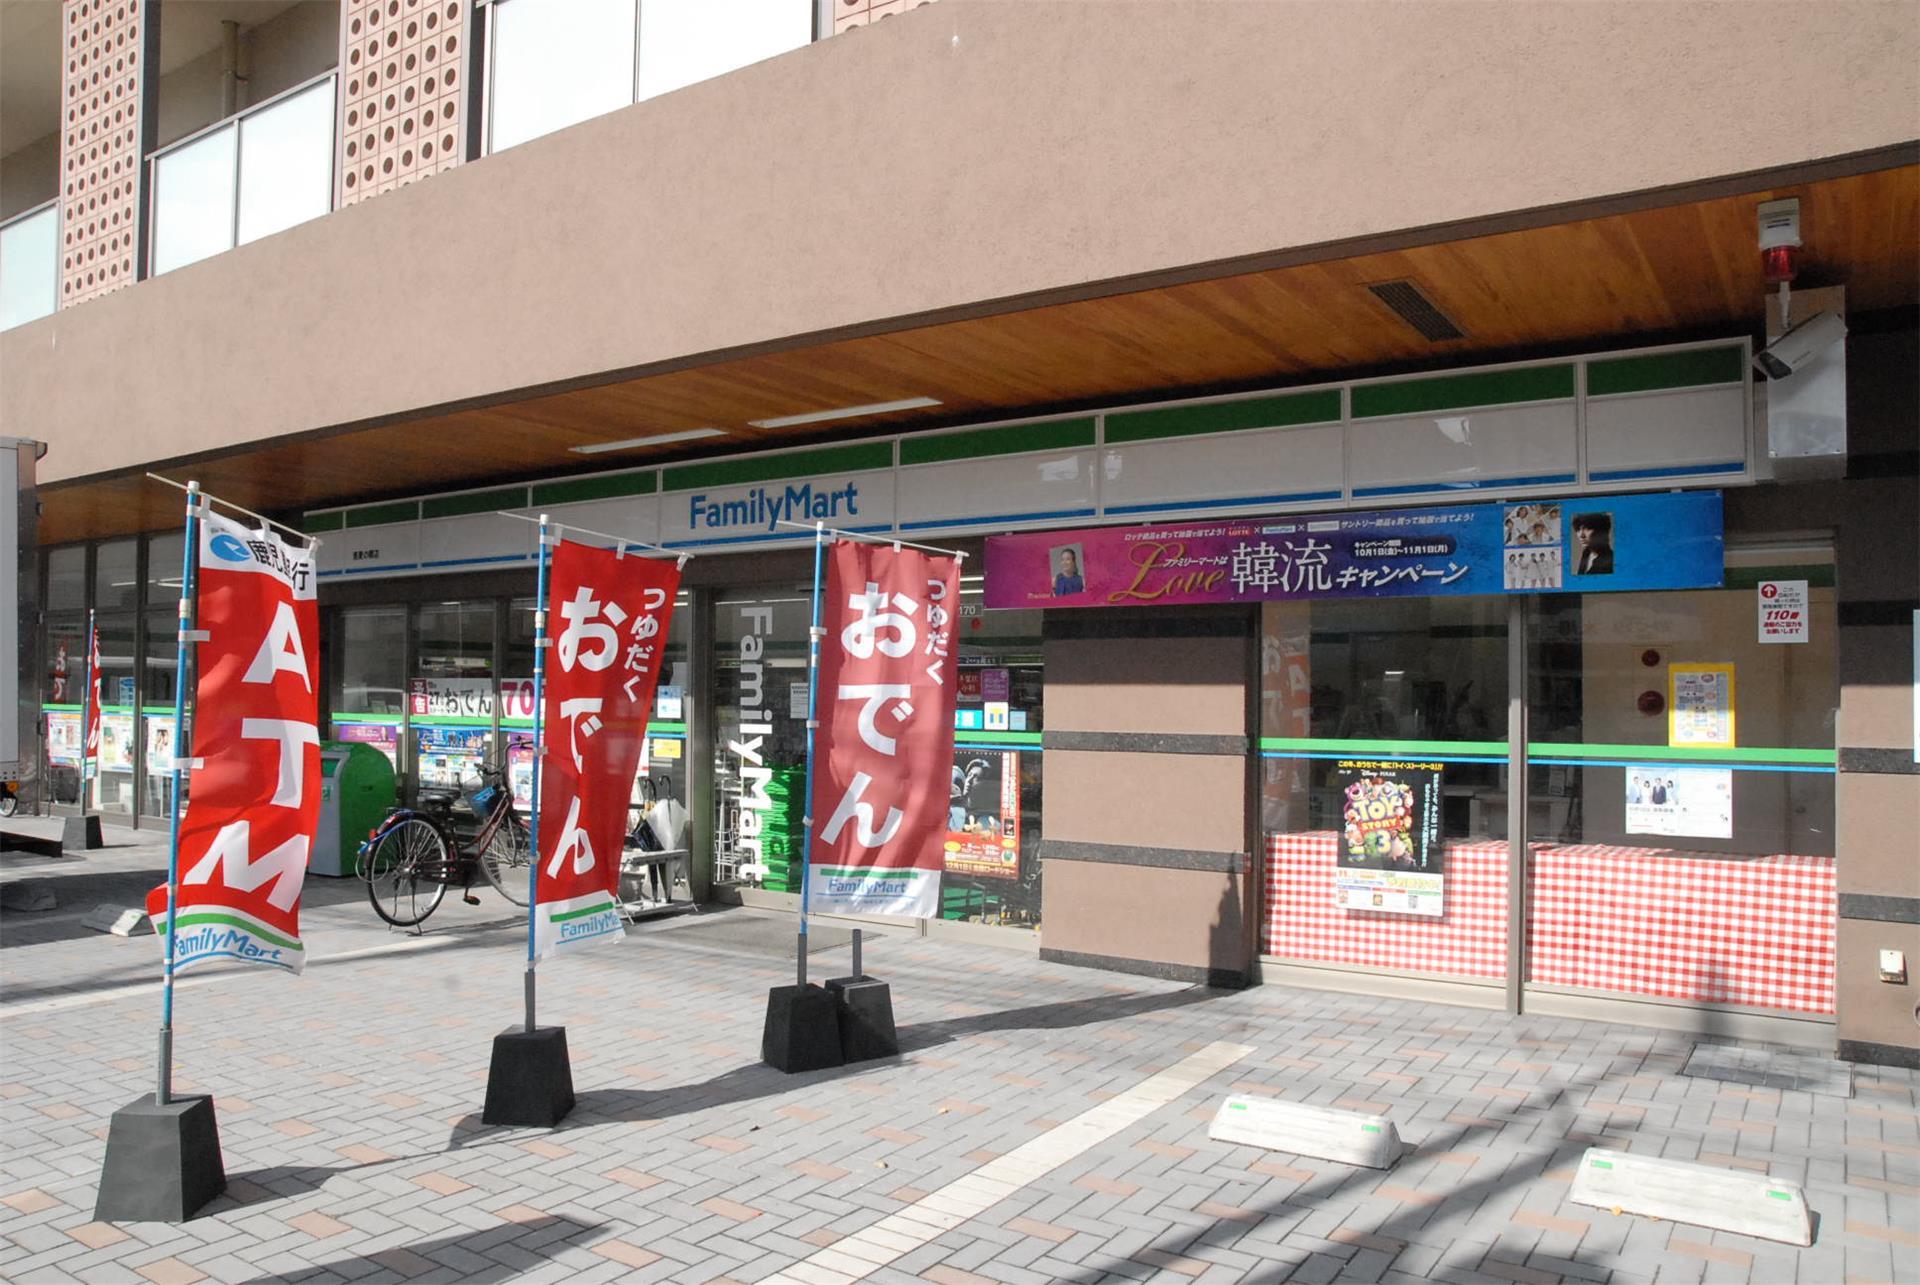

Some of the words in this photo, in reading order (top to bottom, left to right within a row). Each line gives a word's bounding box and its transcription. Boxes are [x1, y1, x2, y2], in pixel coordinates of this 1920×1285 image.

[690, 482, 858, 532] FamilyMart
[1107, 541, 1226, 602] Love
[1163, 556, 1229, 567] ファミリーマートは
[1231, 538, 1333, 594] 韓流
[1336, 562, 1469, 588] キャンペーン
[623, 587, 666, 703] つゆだく
[925, 579, 949, 686] つゆだく
[445, 688, 492, 714] おでん
[819, 582, 919, 849] おでん
[182, 600, 321, 914] ATM
[546, 586, 628, 880] おでん
[729, 606, 774, 883] FamilyMart
[1352, 794, 1404, 822] TOY
[1361, 818, 1398, 831] STORY
[1377, 830, 1392, 853] 3
[828, 878, 908, 894] FamilyMart
